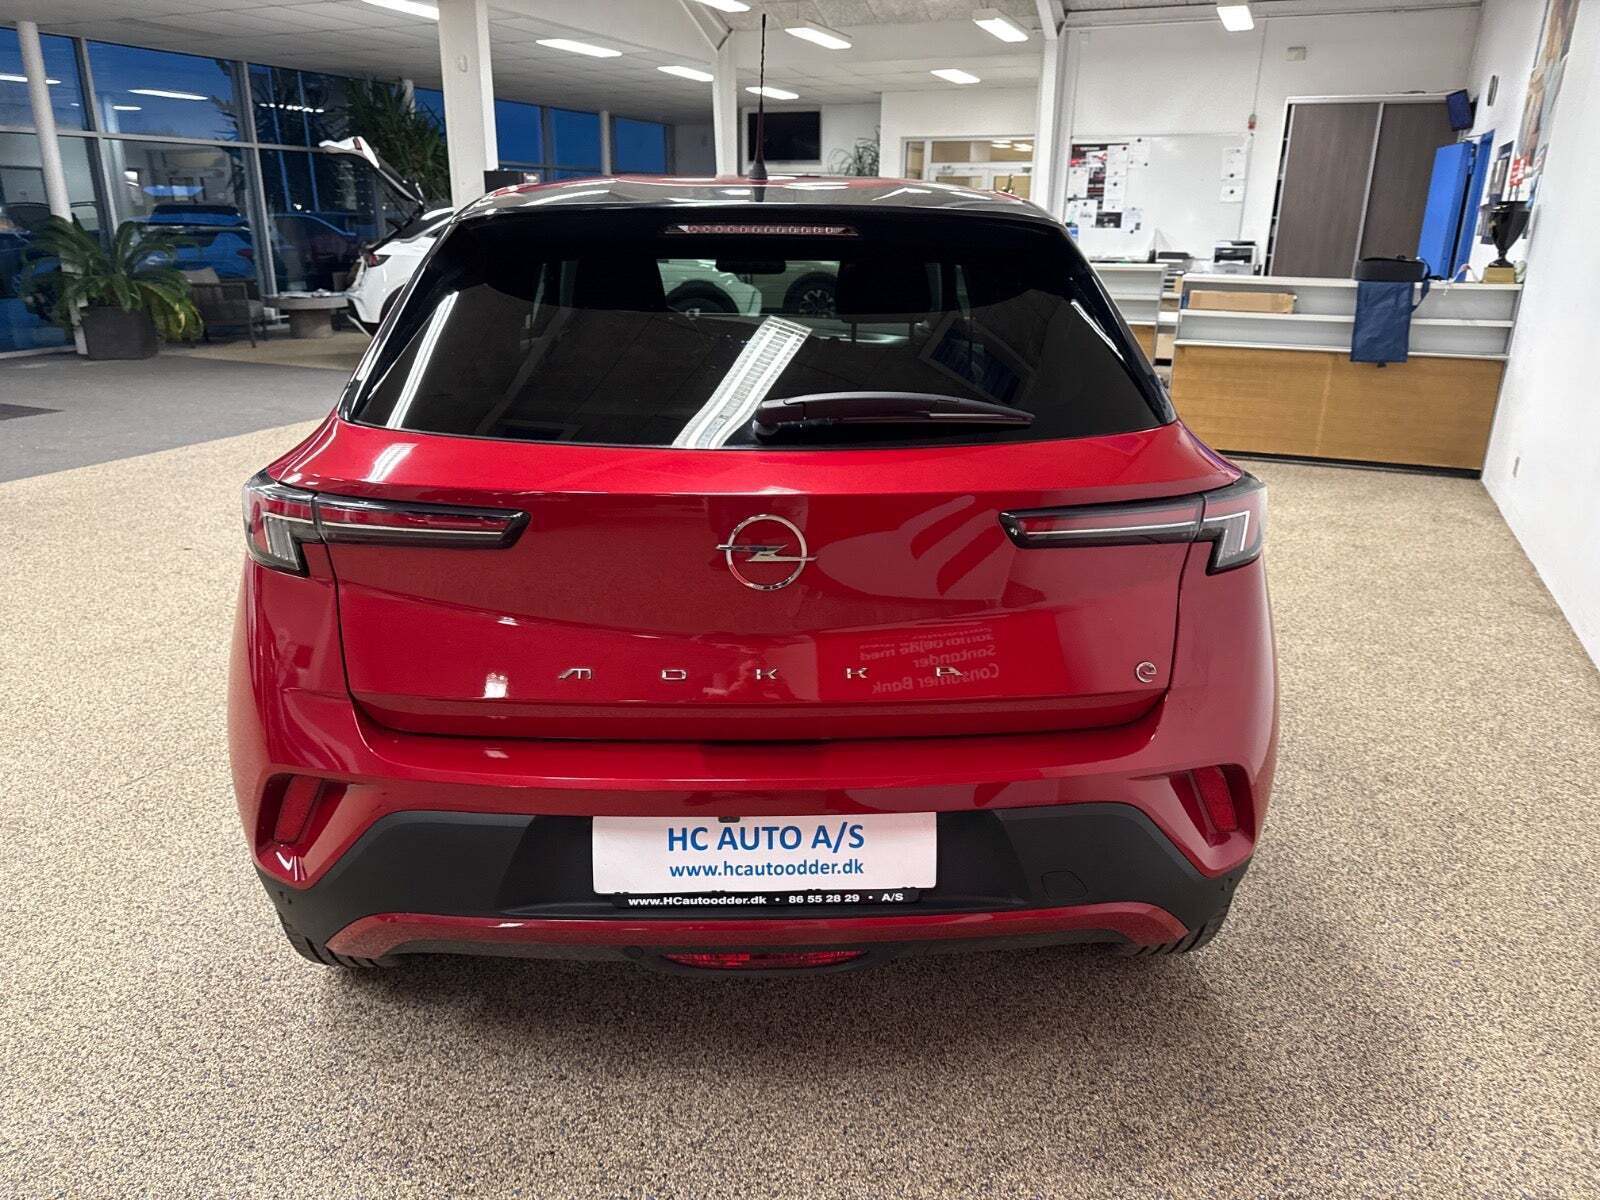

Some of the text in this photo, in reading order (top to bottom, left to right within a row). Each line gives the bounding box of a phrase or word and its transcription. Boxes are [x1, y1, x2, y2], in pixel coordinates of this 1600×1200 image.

[667, 821, 865, 854] HC AUTO A/S
[669, 858, 864, 877] www.hcautoodder.dk
[628, 892, 904, 906] www.HCautoodder.dk 86 55 28 29 A/S
